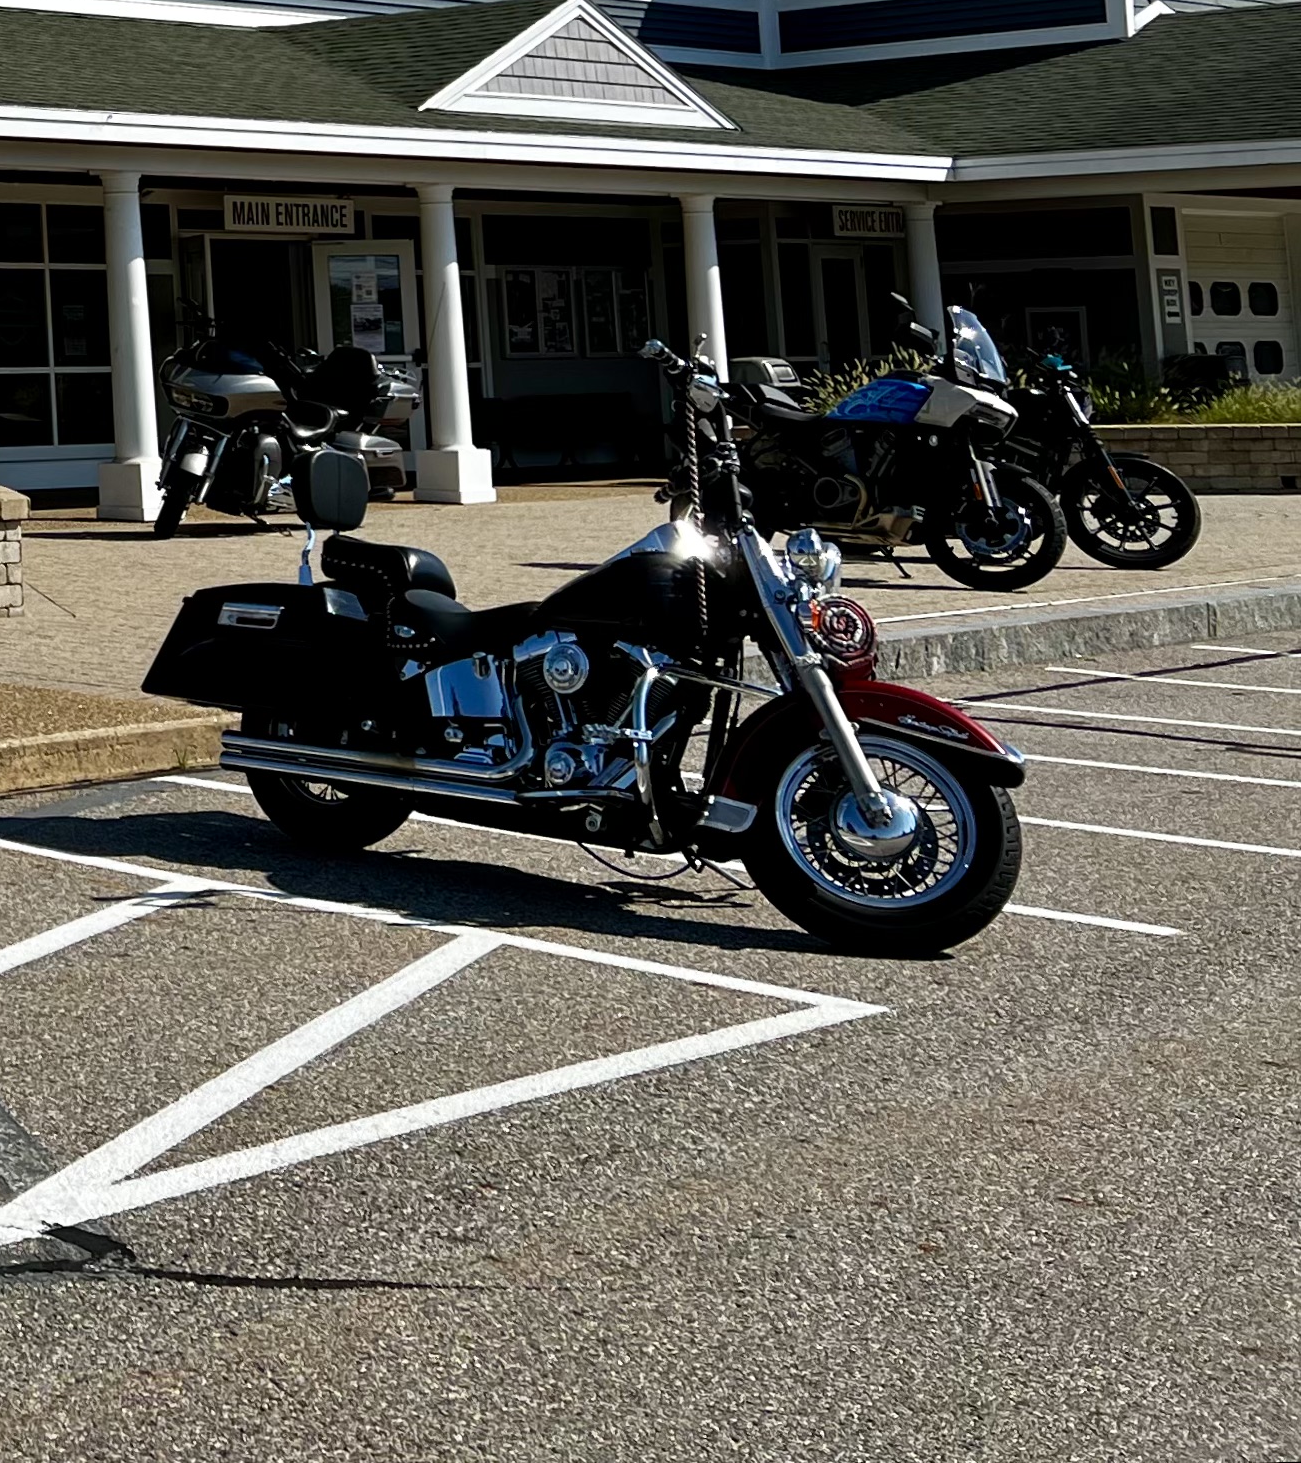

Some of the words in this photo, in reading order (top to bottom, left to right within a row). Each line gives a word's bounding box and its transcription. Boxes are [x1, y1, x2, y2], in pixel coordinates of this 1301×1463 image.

[232, 201, 270, 226] MAIN
[275, 202, 348, 228] ENTRANCE
[838, 209, 878, 233] SERVICE
